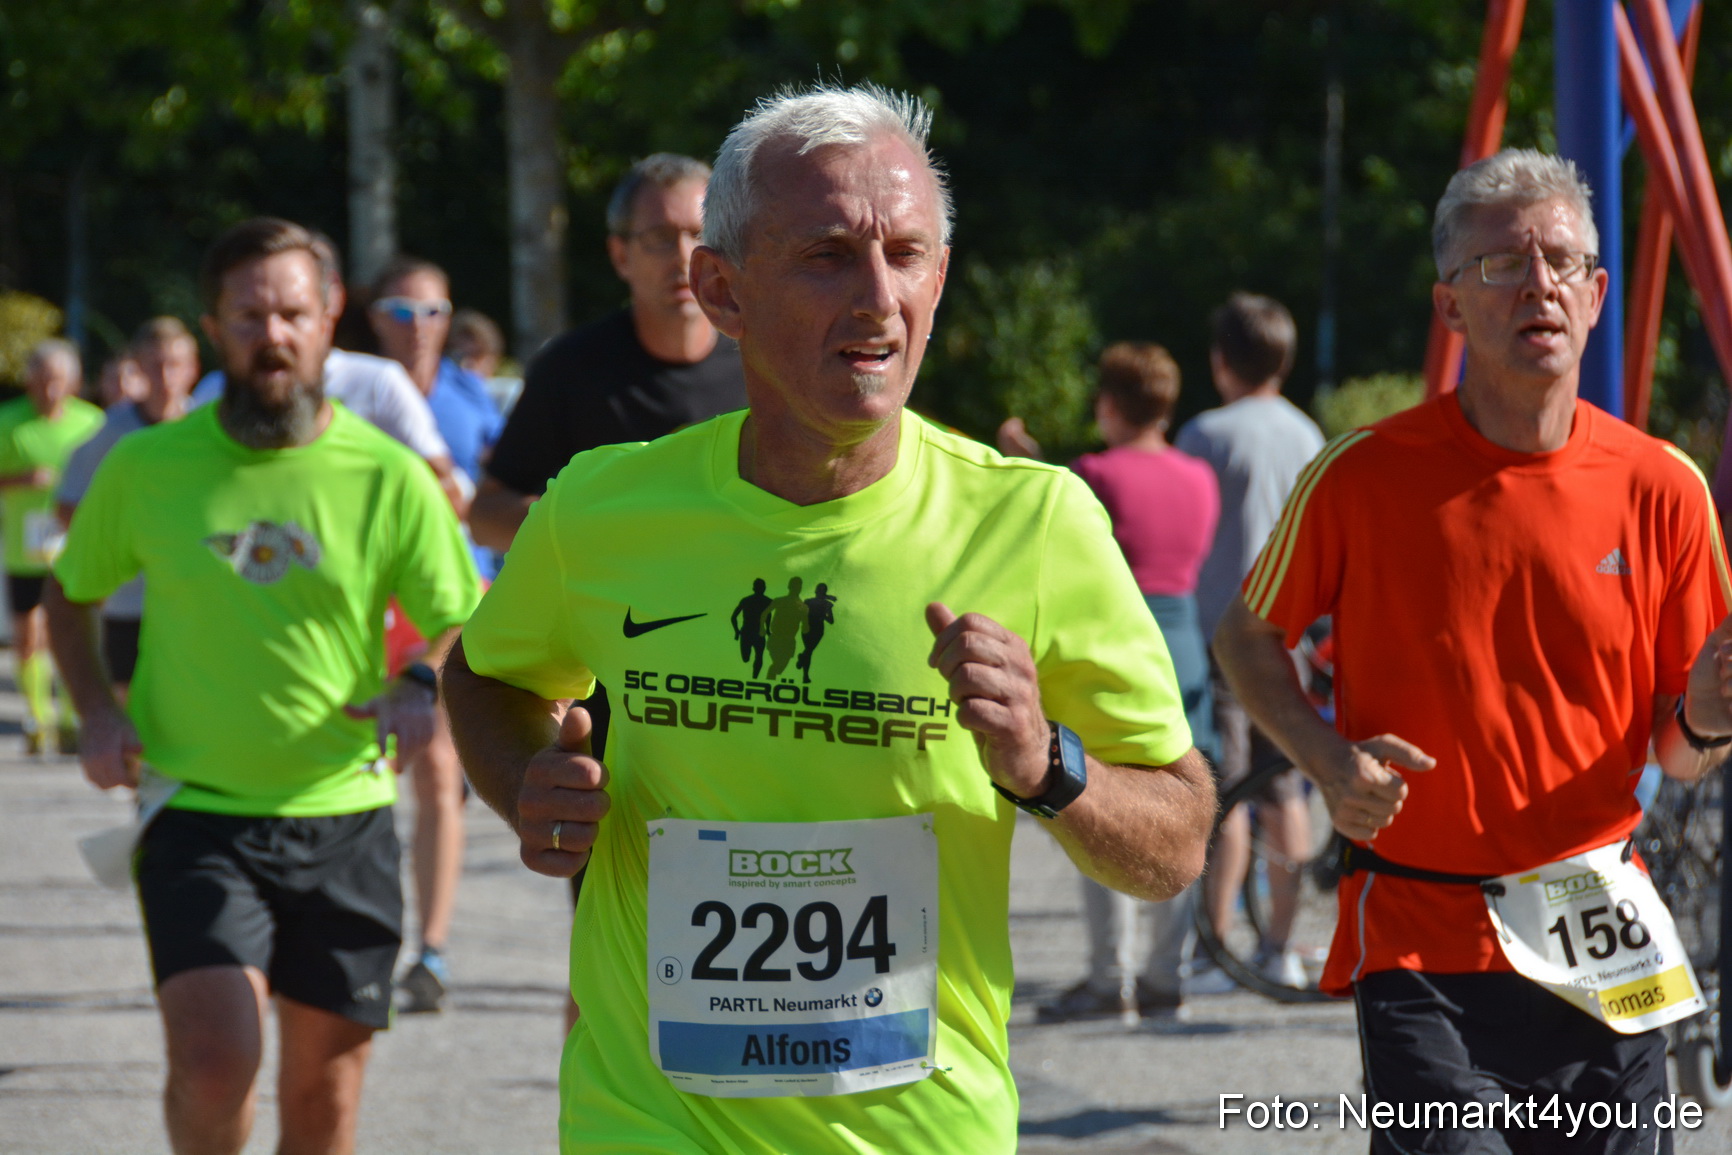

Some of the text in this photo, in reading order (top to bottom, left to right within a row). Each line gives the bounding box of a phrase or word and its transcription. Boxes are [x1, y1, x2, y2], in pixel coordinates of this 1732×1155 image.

[624, 669, 658, 691] SC
[728, 848, 856, 878] BOCK
[728, 876, 856, 889] inspired by smart concepts
[1544, 870, 1613, 901] BOC
[691, 895, 896, 982] 2294
[1548, 898, 1651, 969] 158
[664, 963, 674, 979] B
[709, 996, 769, 1012] PARTL
[774, 993, 858, 1012] Neumarkt
[741, 1033, 851, 1066] Alfons
